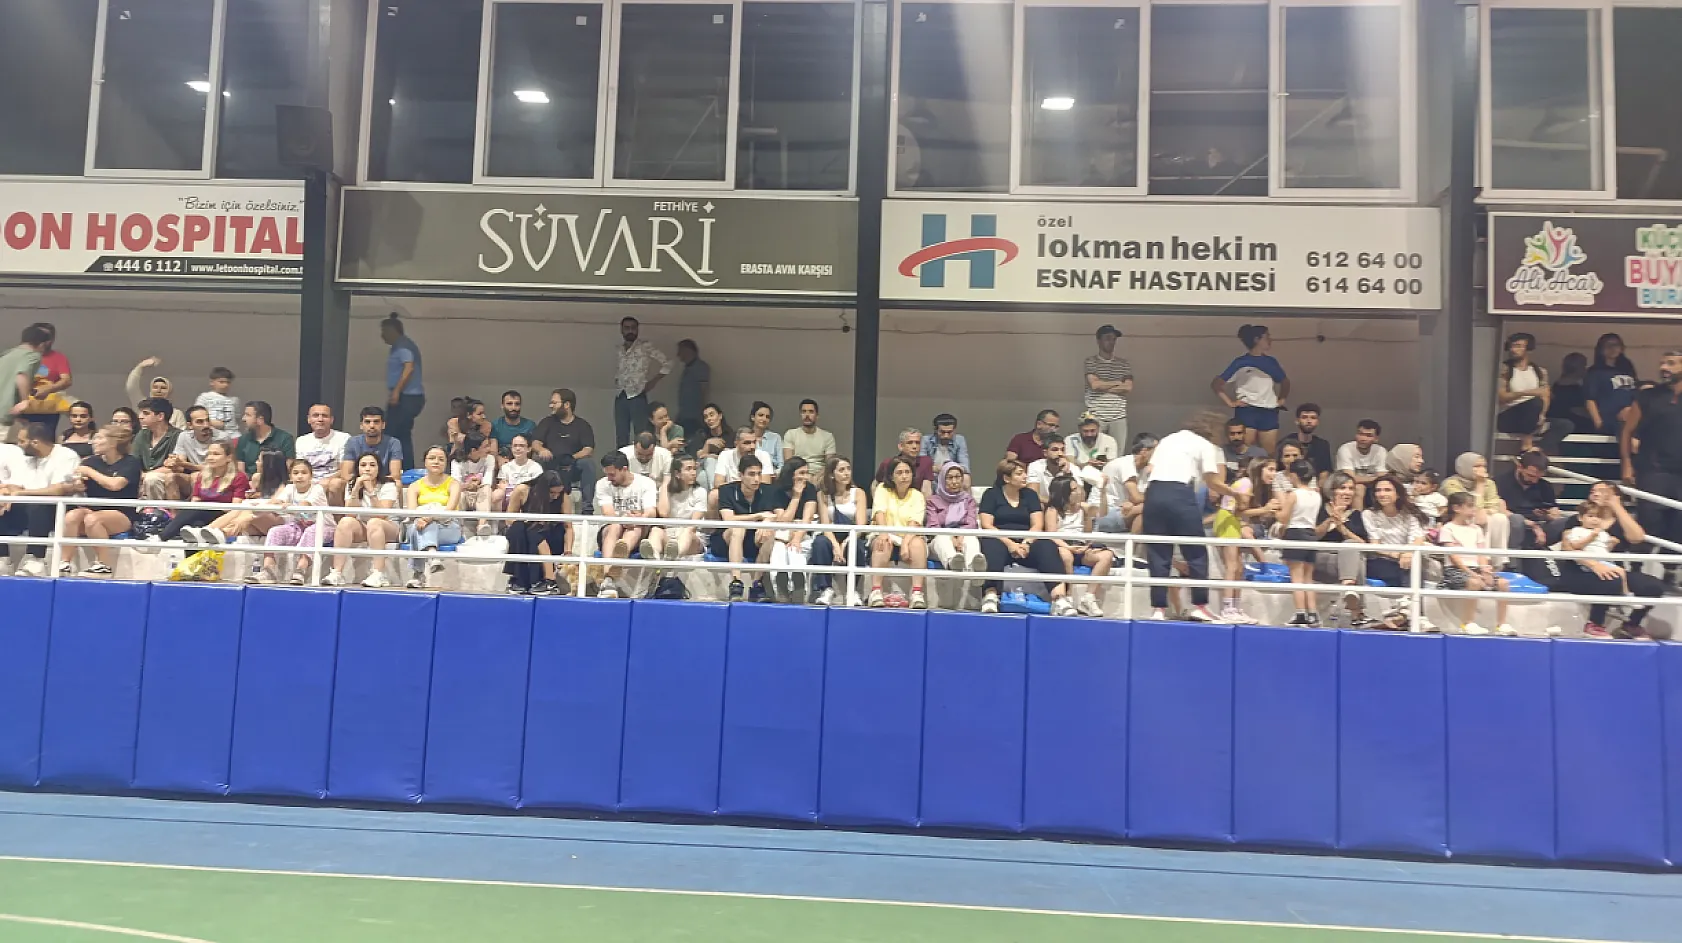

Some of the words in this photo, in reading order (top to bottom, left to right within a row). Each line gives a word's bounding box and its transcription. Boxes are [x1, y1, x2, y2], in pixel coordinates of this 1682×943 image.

[221, 200, 241, 213] için
[653, 200, 699, 213] FETHİYE
[1037, 215, 1073, 228] özel
[0, 211, 73, 251] ON
[86, 212, 304, 255] HOSPITAL
[478, 202, 719, 286] SÜVARİ
[114, 259, 140, 272] 444
[143, 260, 152, 272] 6
[156, 260, 181, 273] 112
[1306, 251, 1349, 268] 612
[1357, 252, 1385, 269] 64
[1394, 252, 1423, 269] 00
[740, 263, 773, 275] ERASTA
[774, 264, 796, 275] AVM
[798, 264, 833, 279] KARŞISI
[1036, 268, 1122, 290] ESNAF
[1129, 267, 1276, 292] HASTANESİ
[1306, 276, 1349, 294] 614
[1357, 277, 1385, 294] 64
[1394, 278, 1423, 295] 00
